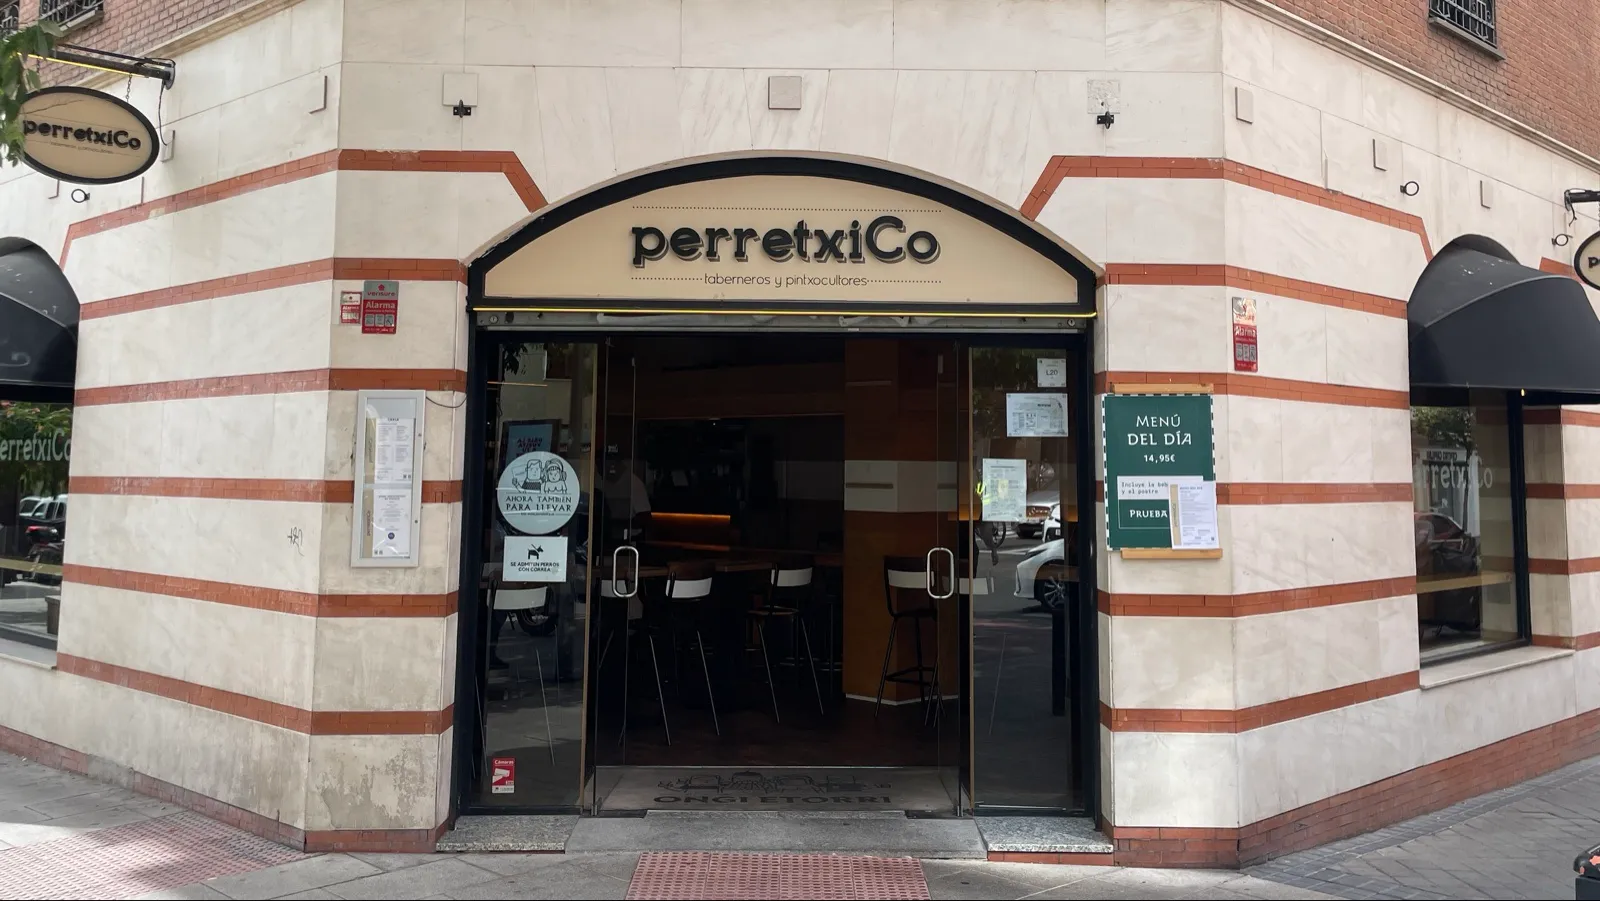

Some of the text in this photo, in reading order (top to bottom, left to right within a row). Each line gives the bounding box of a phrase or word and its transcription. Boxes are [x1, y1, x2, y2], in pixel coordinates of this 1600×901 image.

[22, 120, 141, 150] perretxiCo
[631, 215, 941, 269] perretxiCo
[704, 273, 868, 288] taberneros y pintxocultores
[365, 301, 396, 309] Alarma
[0, 427, 72, 461] erretxiCo
[1127, 430, 1192, 446] DEL DÍA
[1143, 454, 1176, 464] 14,95€
[1129, 509, 1168, 518] PRUEBA
[653, 796, 892, 804] ONGI ETORRI
